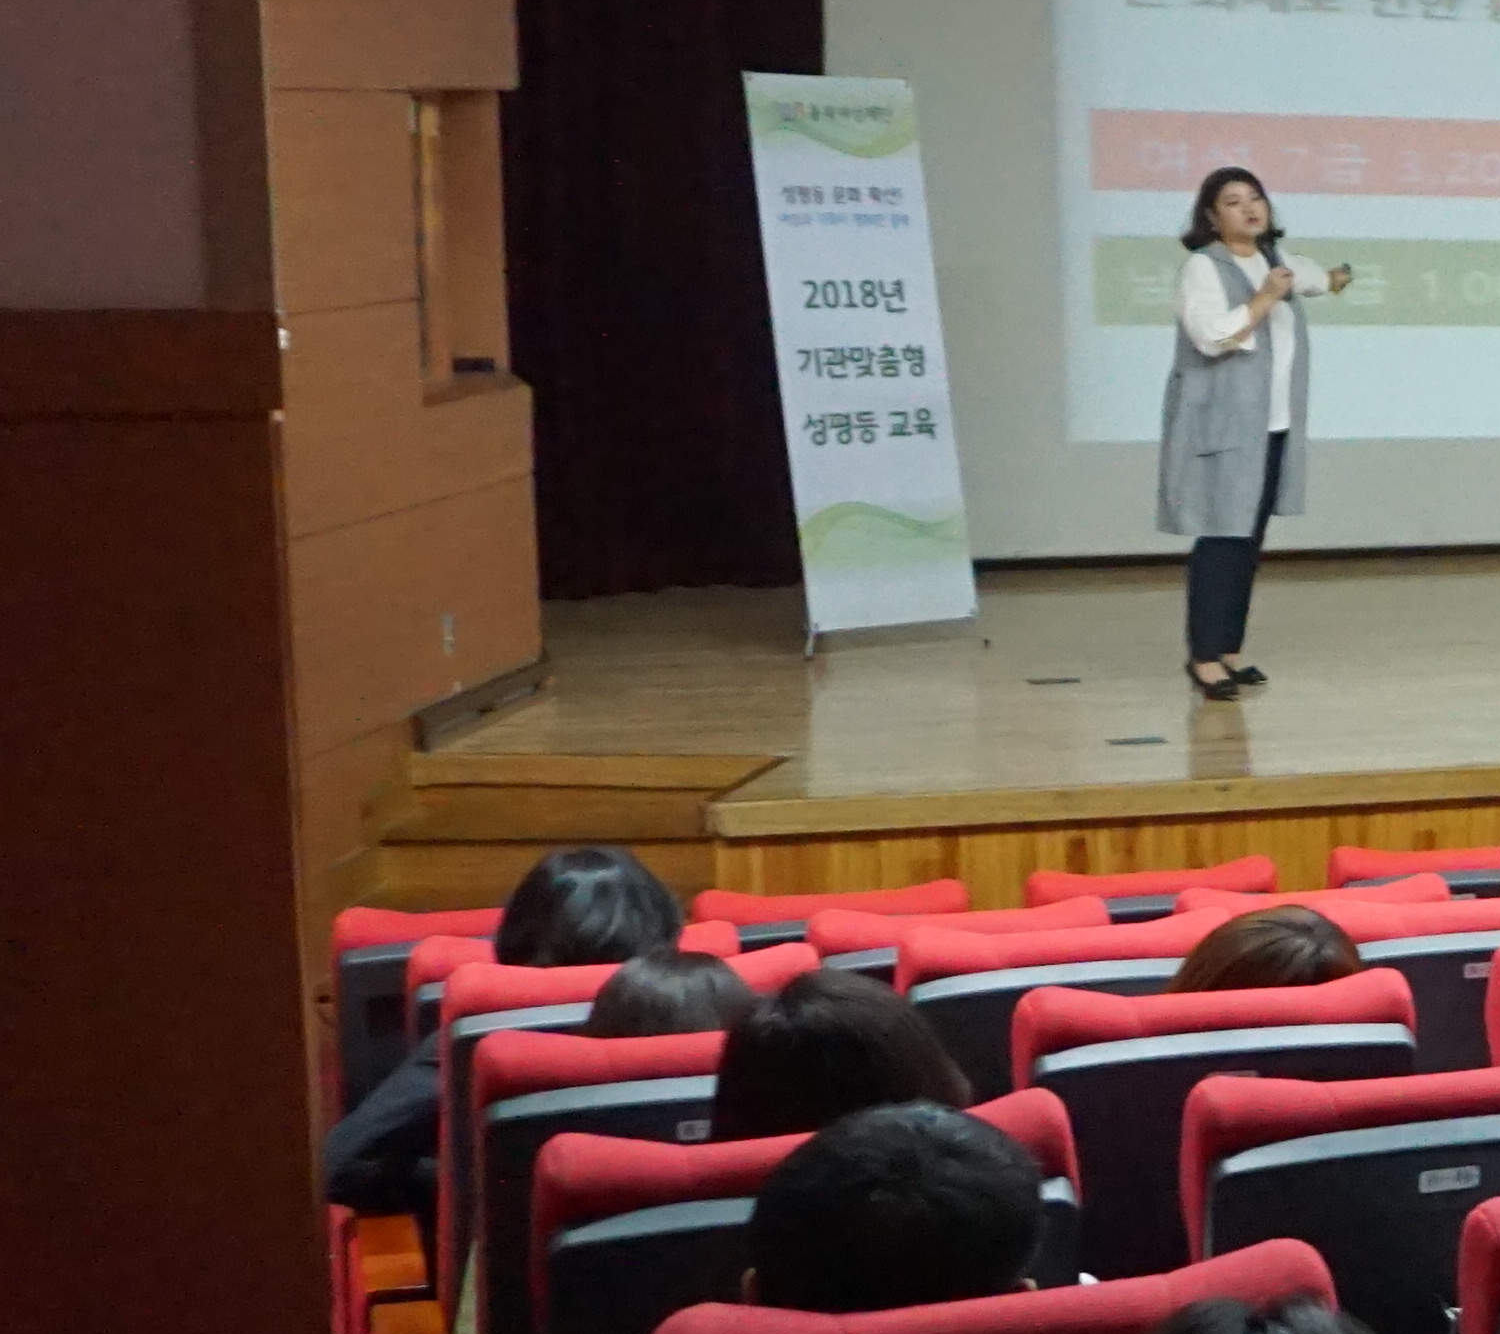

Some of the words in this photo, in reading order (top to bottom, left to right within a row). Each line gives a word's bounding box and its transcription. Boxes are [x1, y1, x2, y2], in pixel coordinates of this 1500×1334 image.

[802, 278, 909, 314] 2018년
[796, 344, 926, 378] 기관맞춤형
[802, 409, 881, 447] 성평등
[887, 407, 938, 442] 교육
